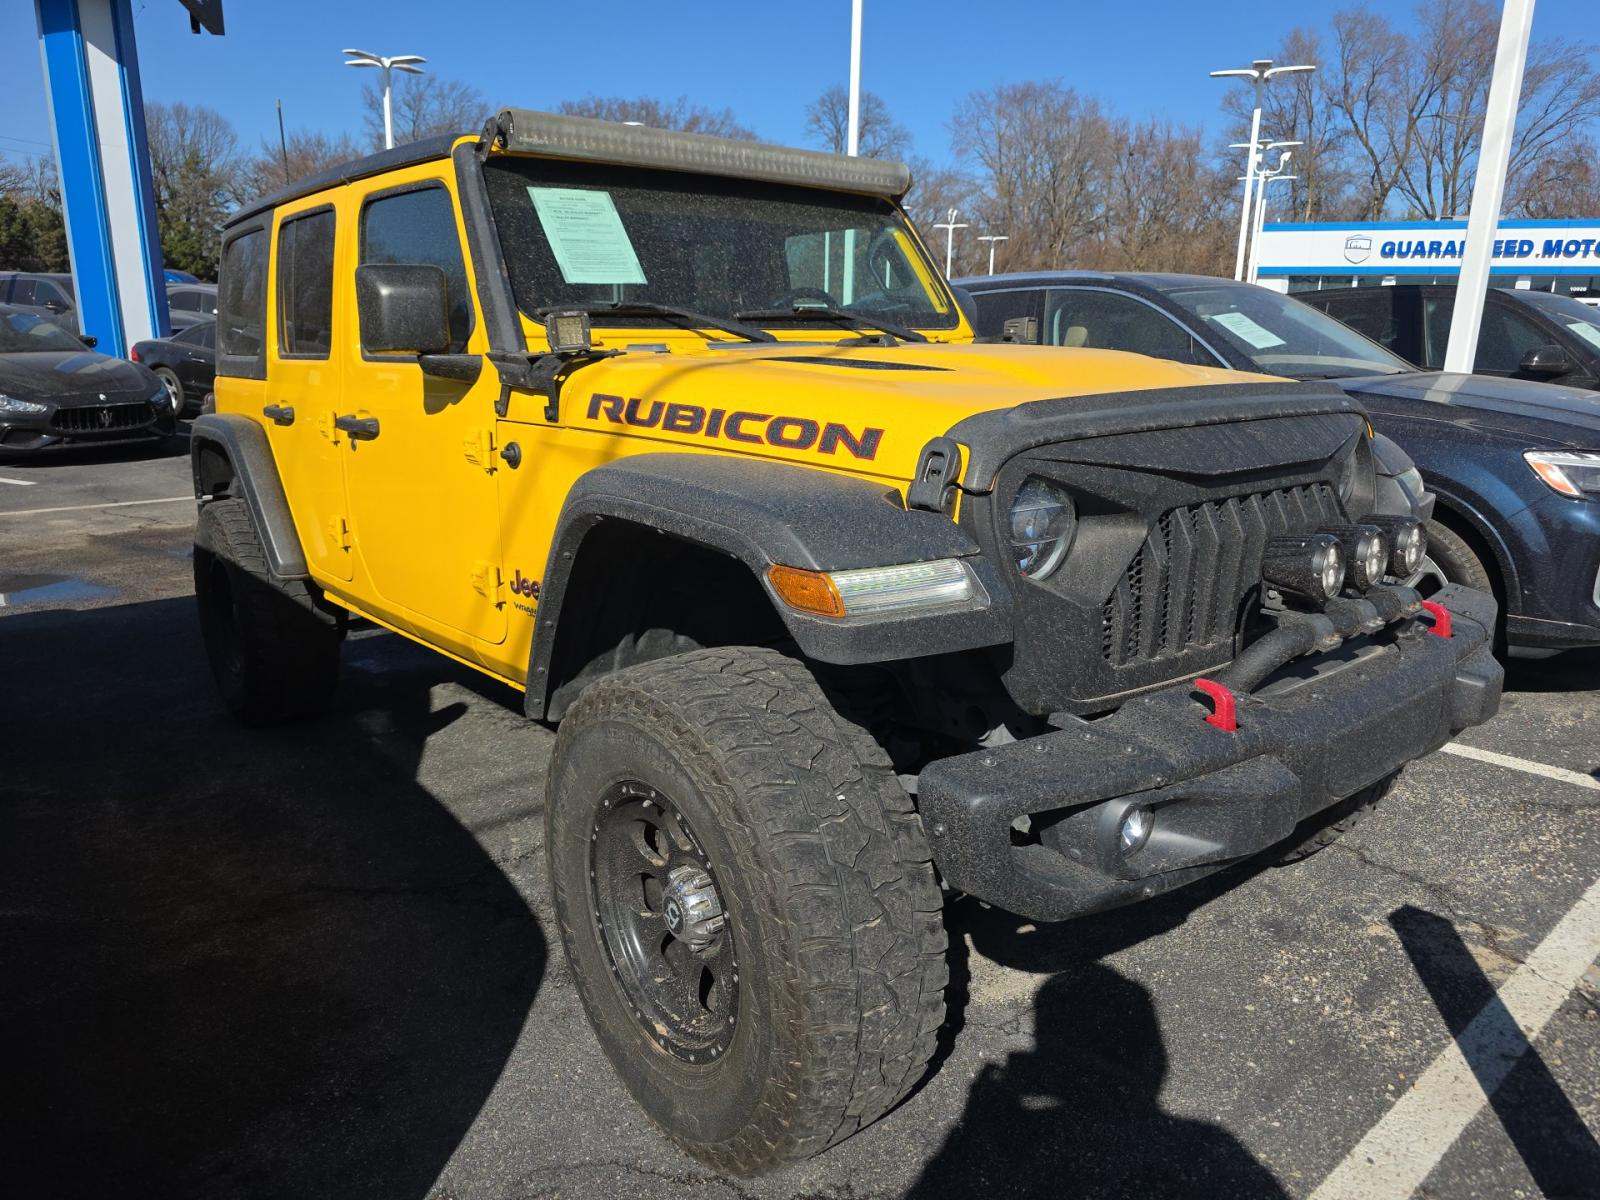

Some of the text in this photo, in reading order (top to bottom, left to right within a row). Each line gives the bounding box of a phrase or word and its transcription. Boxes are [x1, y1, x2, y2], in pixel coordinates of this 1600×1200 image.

[1381, 240, 1600, 258] GUARAEED.MOT
[587, 393, 885, 460] RUBICON
[510, 569, 541, 600] Jee
